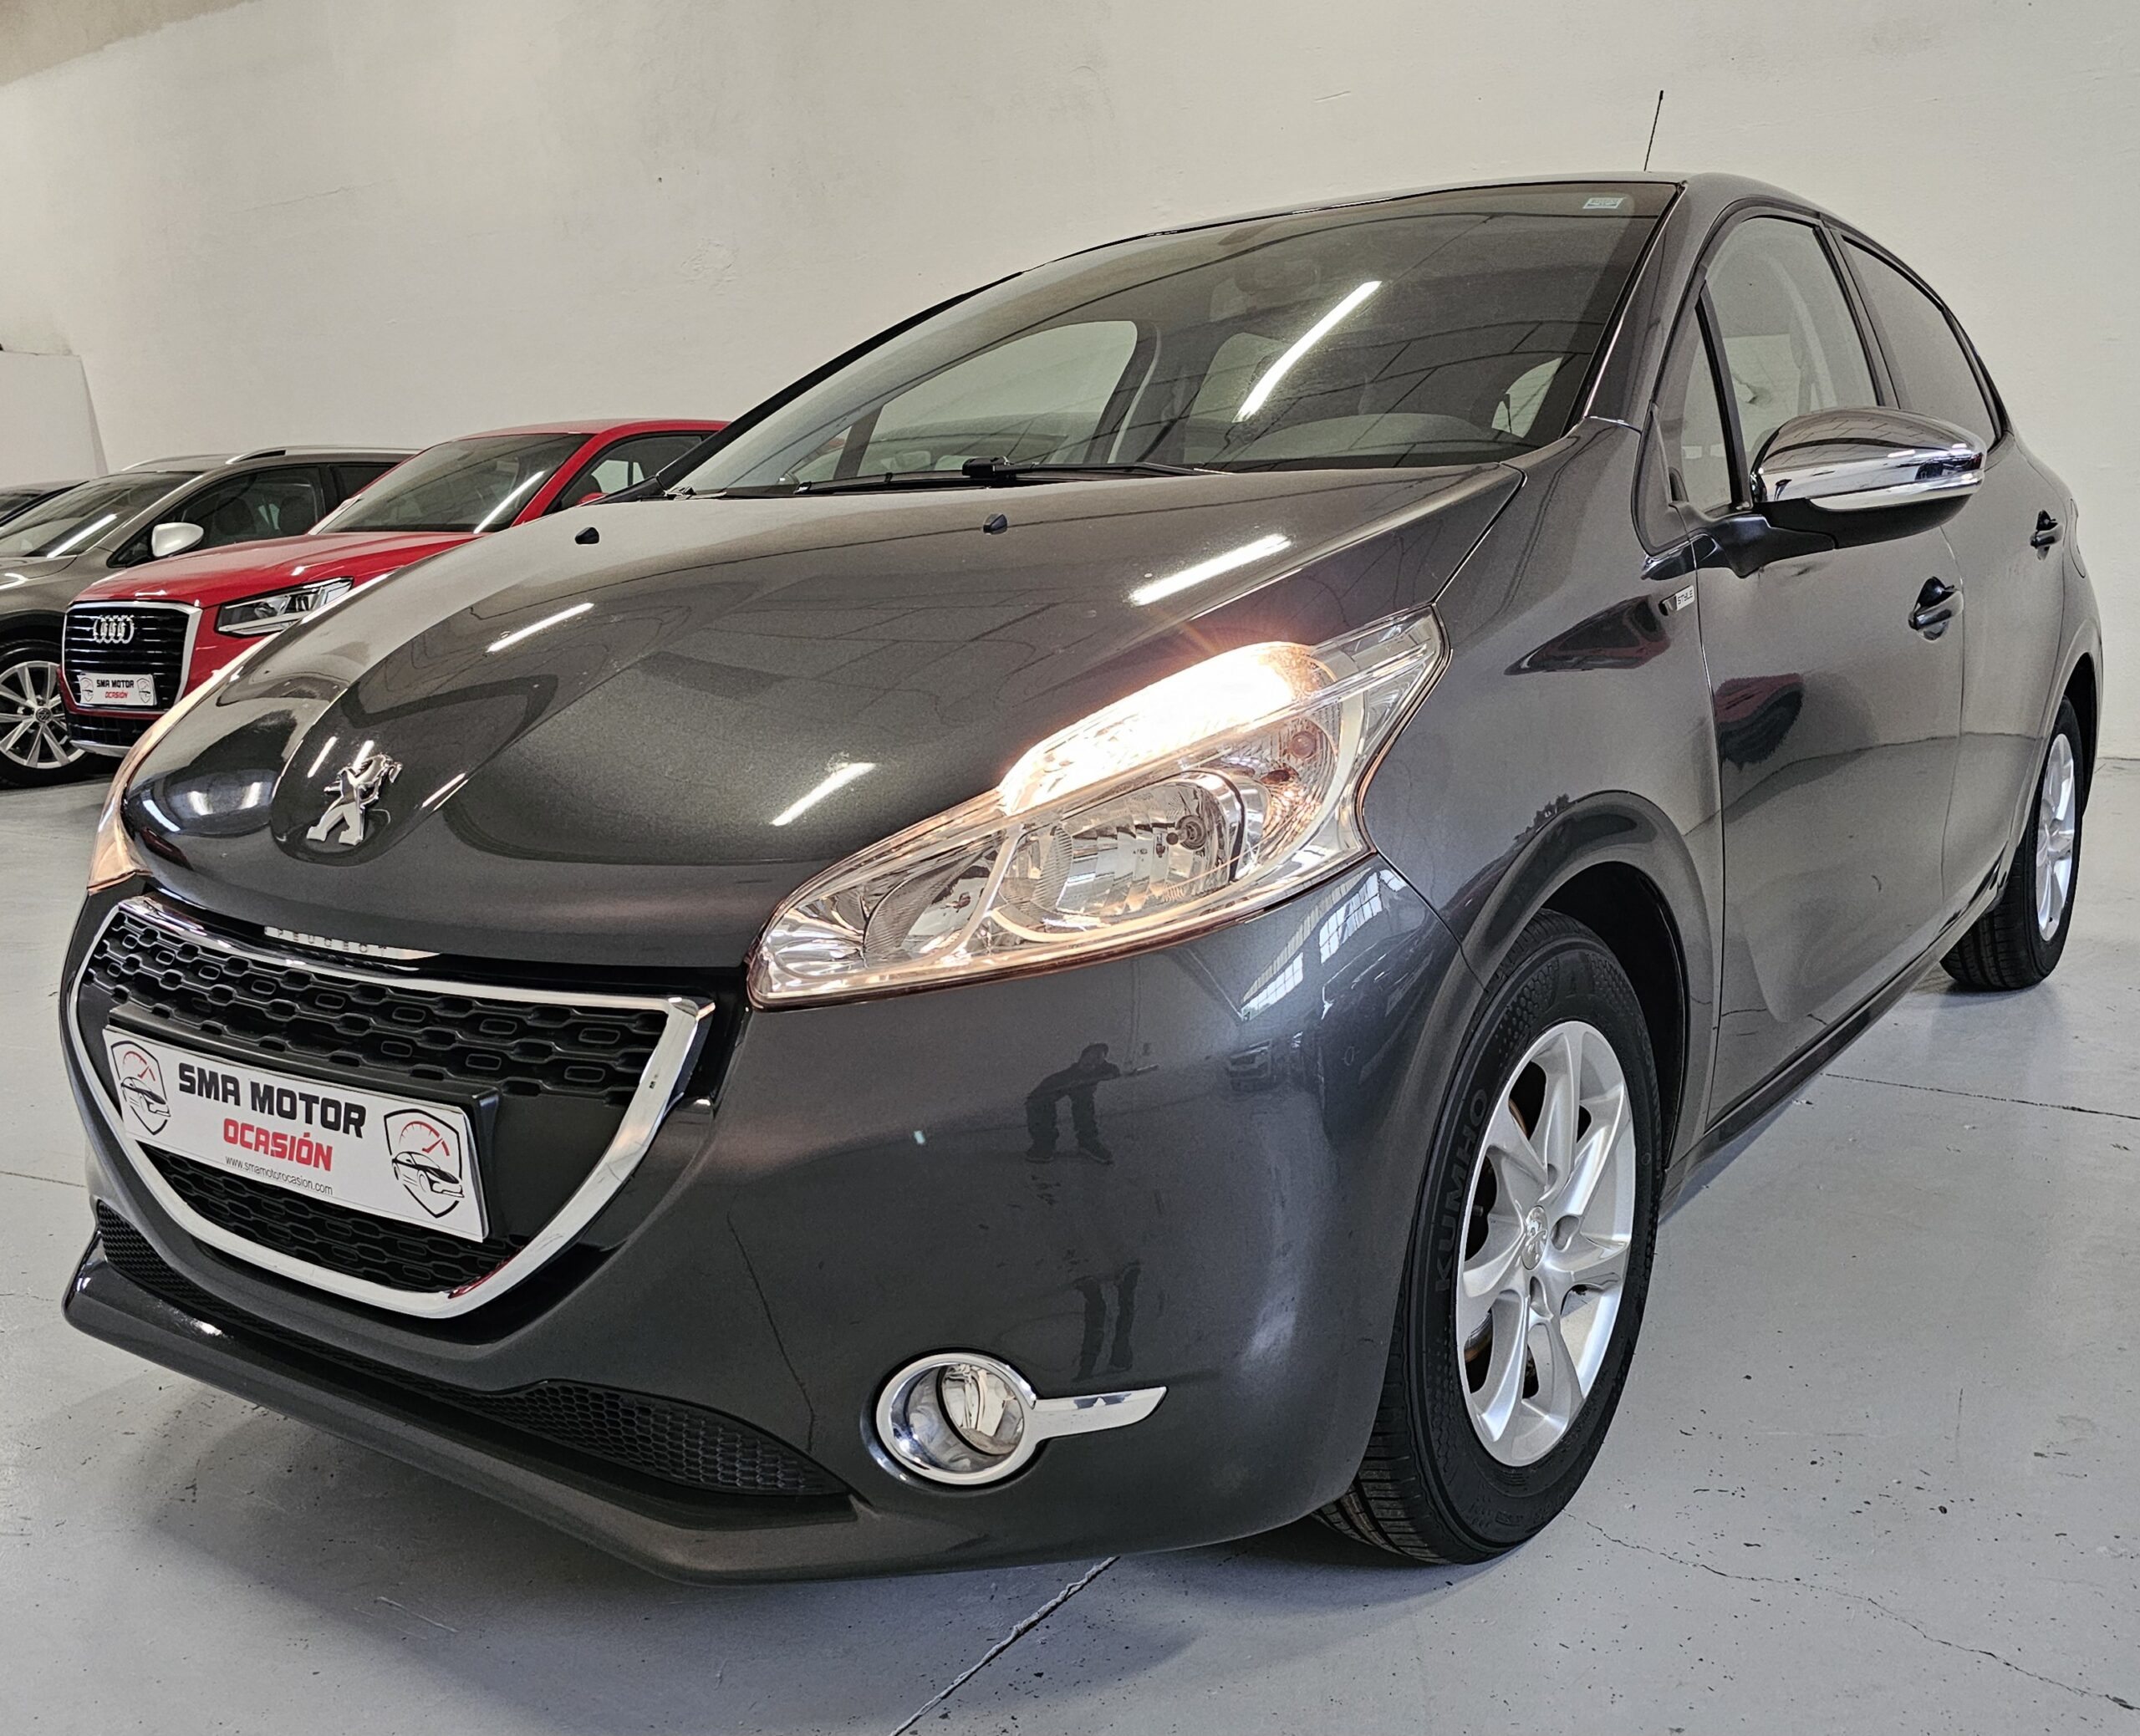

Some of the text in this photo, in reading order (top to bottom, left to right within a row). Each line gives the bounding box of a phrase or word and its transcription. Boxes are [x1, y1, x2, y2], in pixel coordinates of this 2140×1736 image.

[1678, 590, 1694, 604] STYLE
[96, 680, 134, 688] SMA MOTOR
[178, 1062, 366, 1138] SMA MOTOR
[223, 1117, 334, 1172] OCASIÓN
[225, 1155, 334, 1195] www.smamotorocasion.com
[1434, 1088, 1488, 1292] KUMHO
